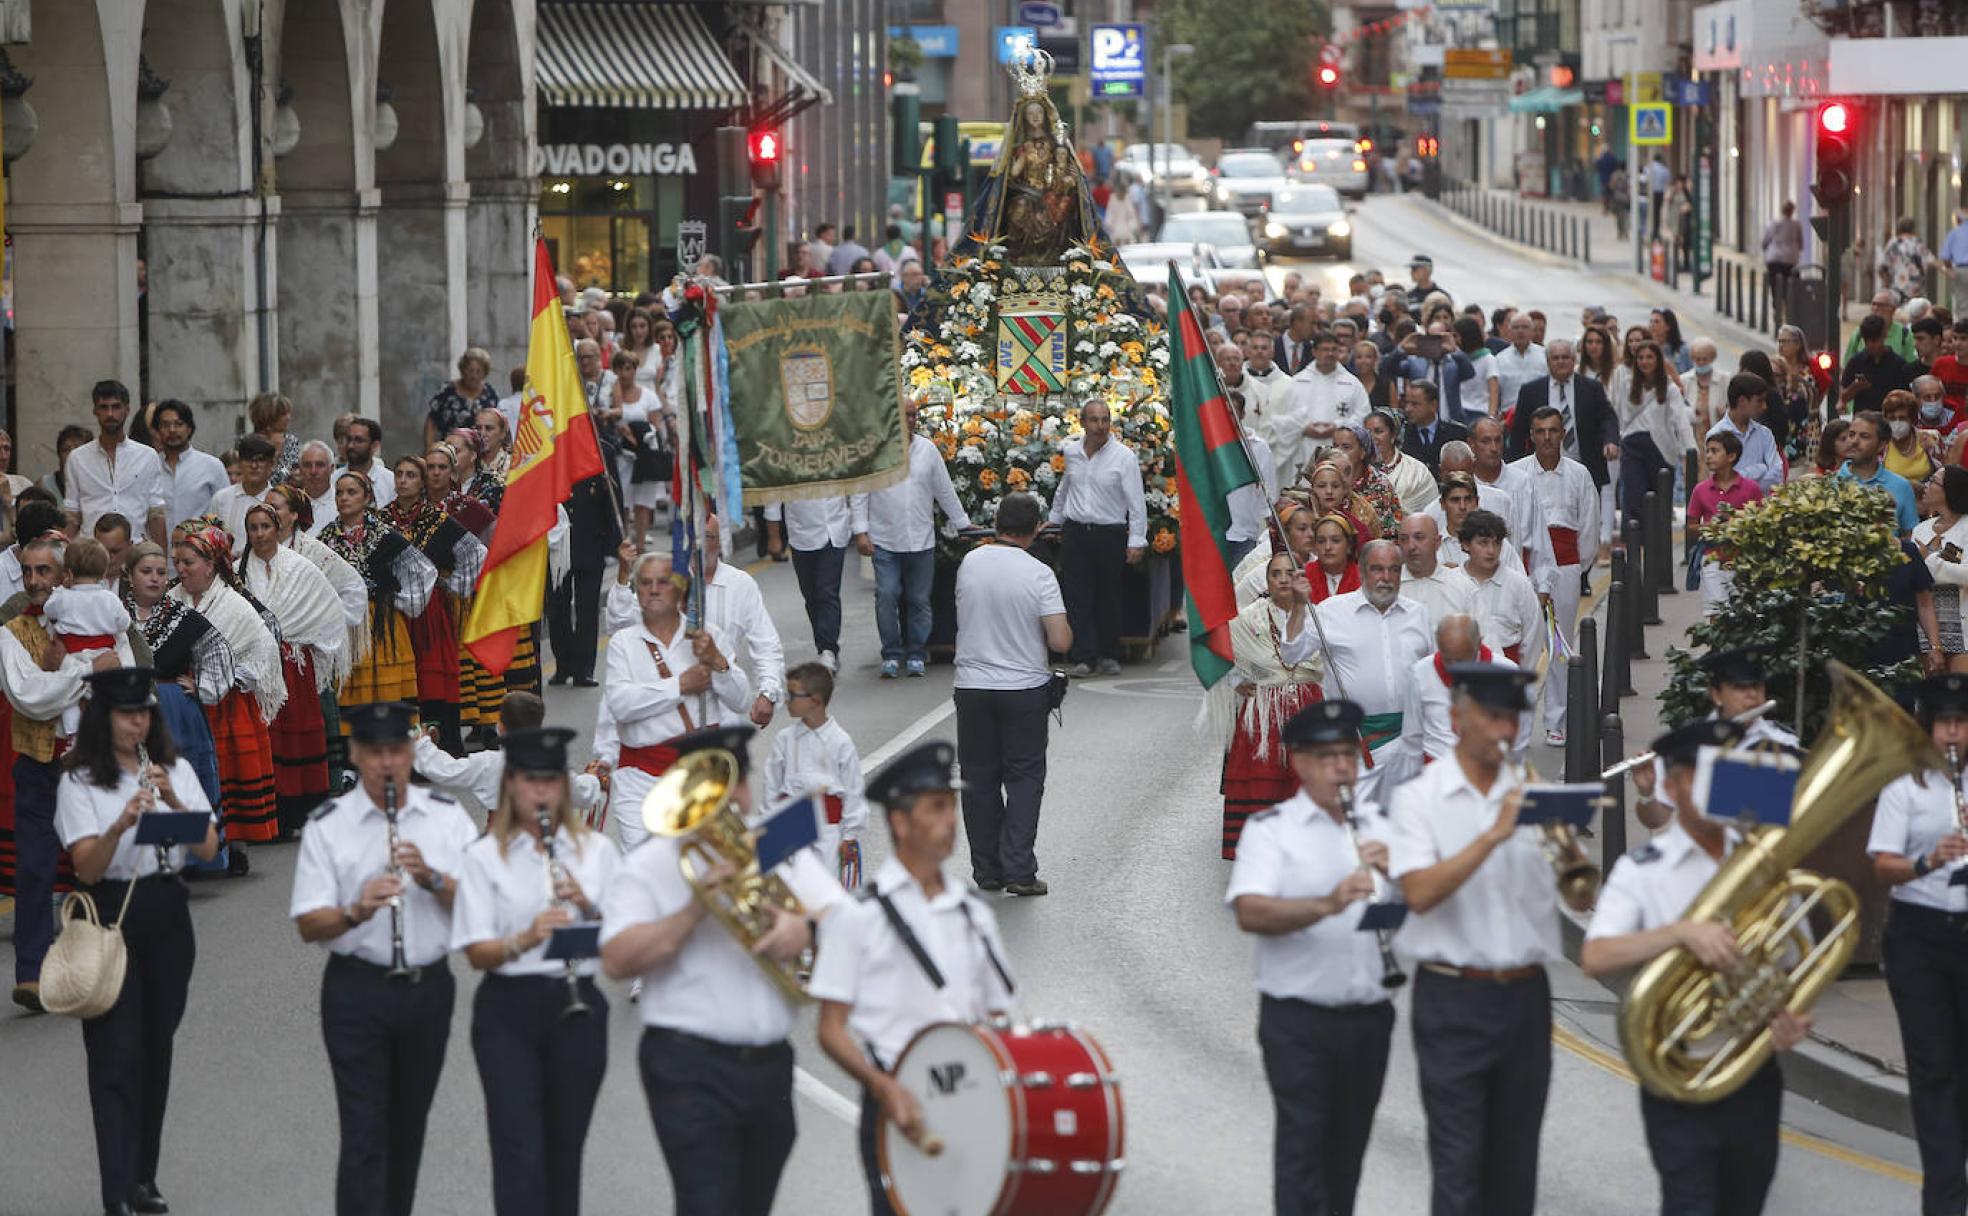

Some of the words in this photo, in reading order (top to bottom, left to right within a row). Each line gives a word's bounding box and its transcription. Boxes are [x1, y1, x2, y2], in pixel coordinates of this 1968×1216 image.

[1093, 28, 1124, 69] P
[1000, 340, 1013, 369] AVE
[929, 1063, 965, 1093] NP
